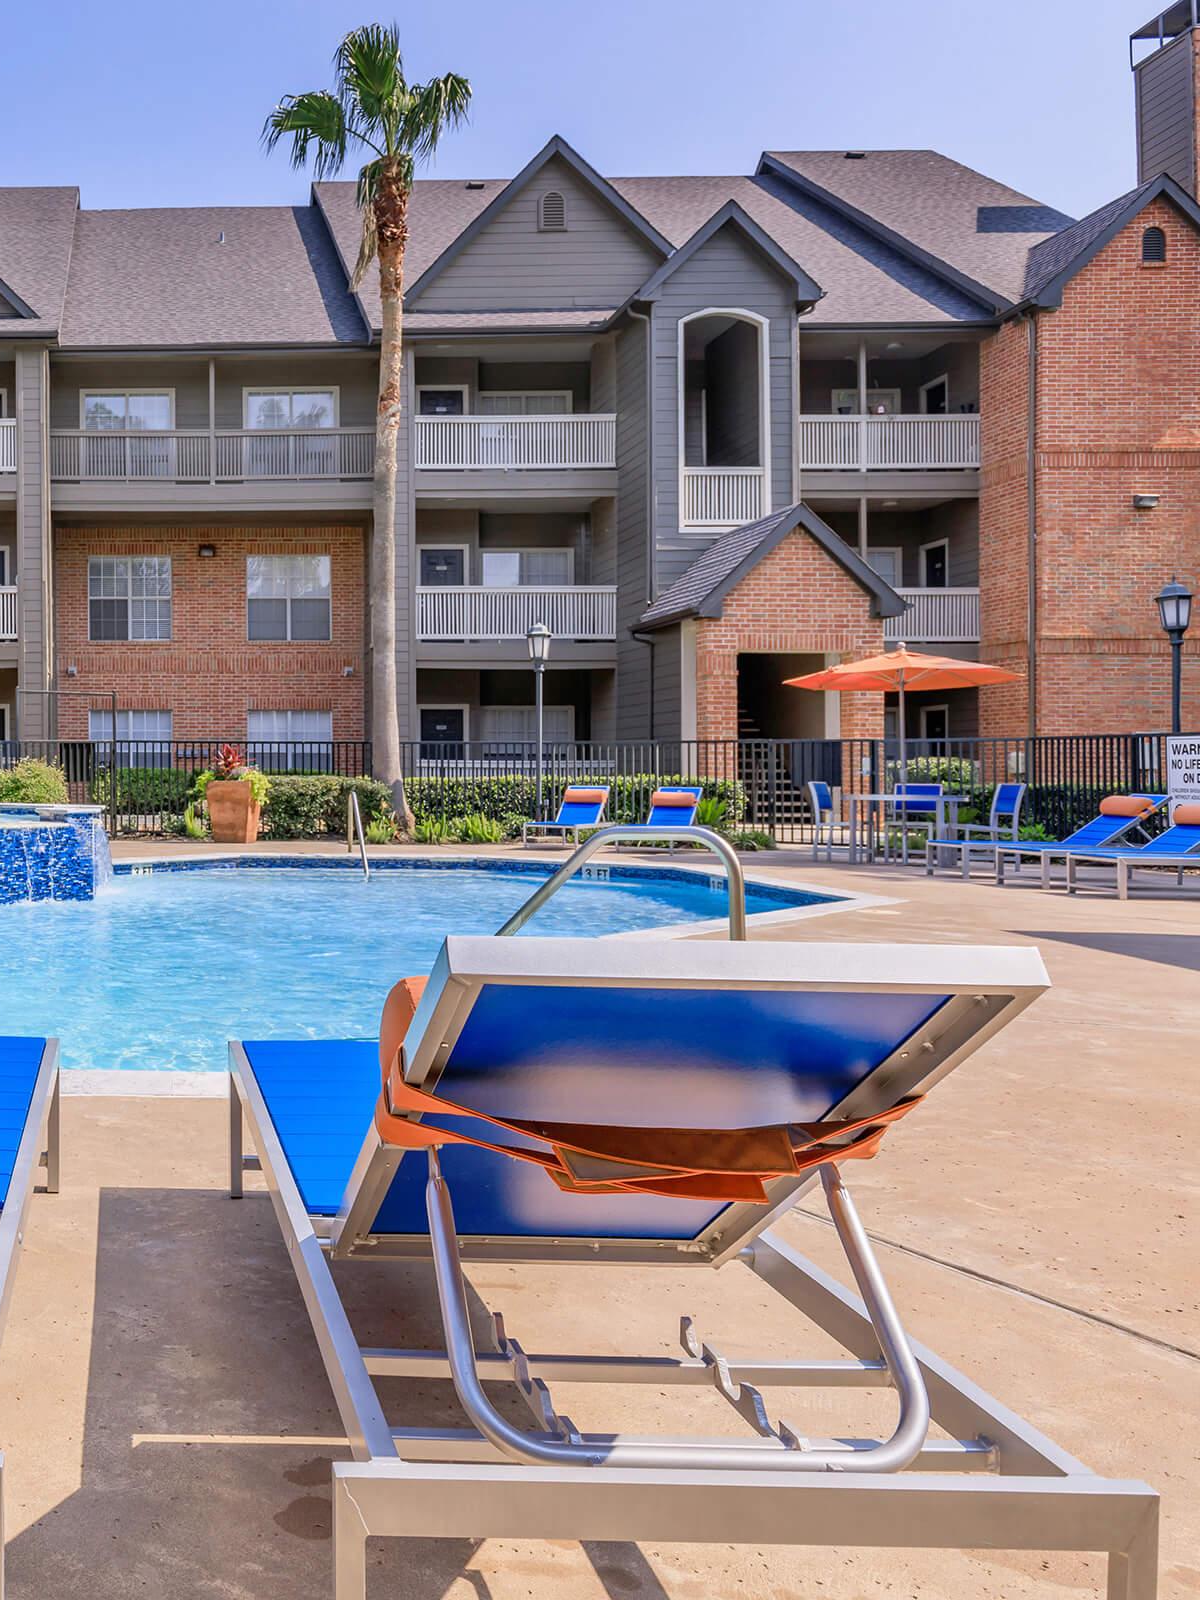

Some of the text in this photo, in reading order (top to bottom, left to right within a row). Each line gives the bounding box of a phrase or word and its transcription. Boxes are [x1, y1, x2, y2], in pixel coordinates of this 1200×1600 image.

[1171, 759, 1183, 770] NO
[1183, 772, 1195, 784] ON
[585, 868, 609, 881] 3 FT
